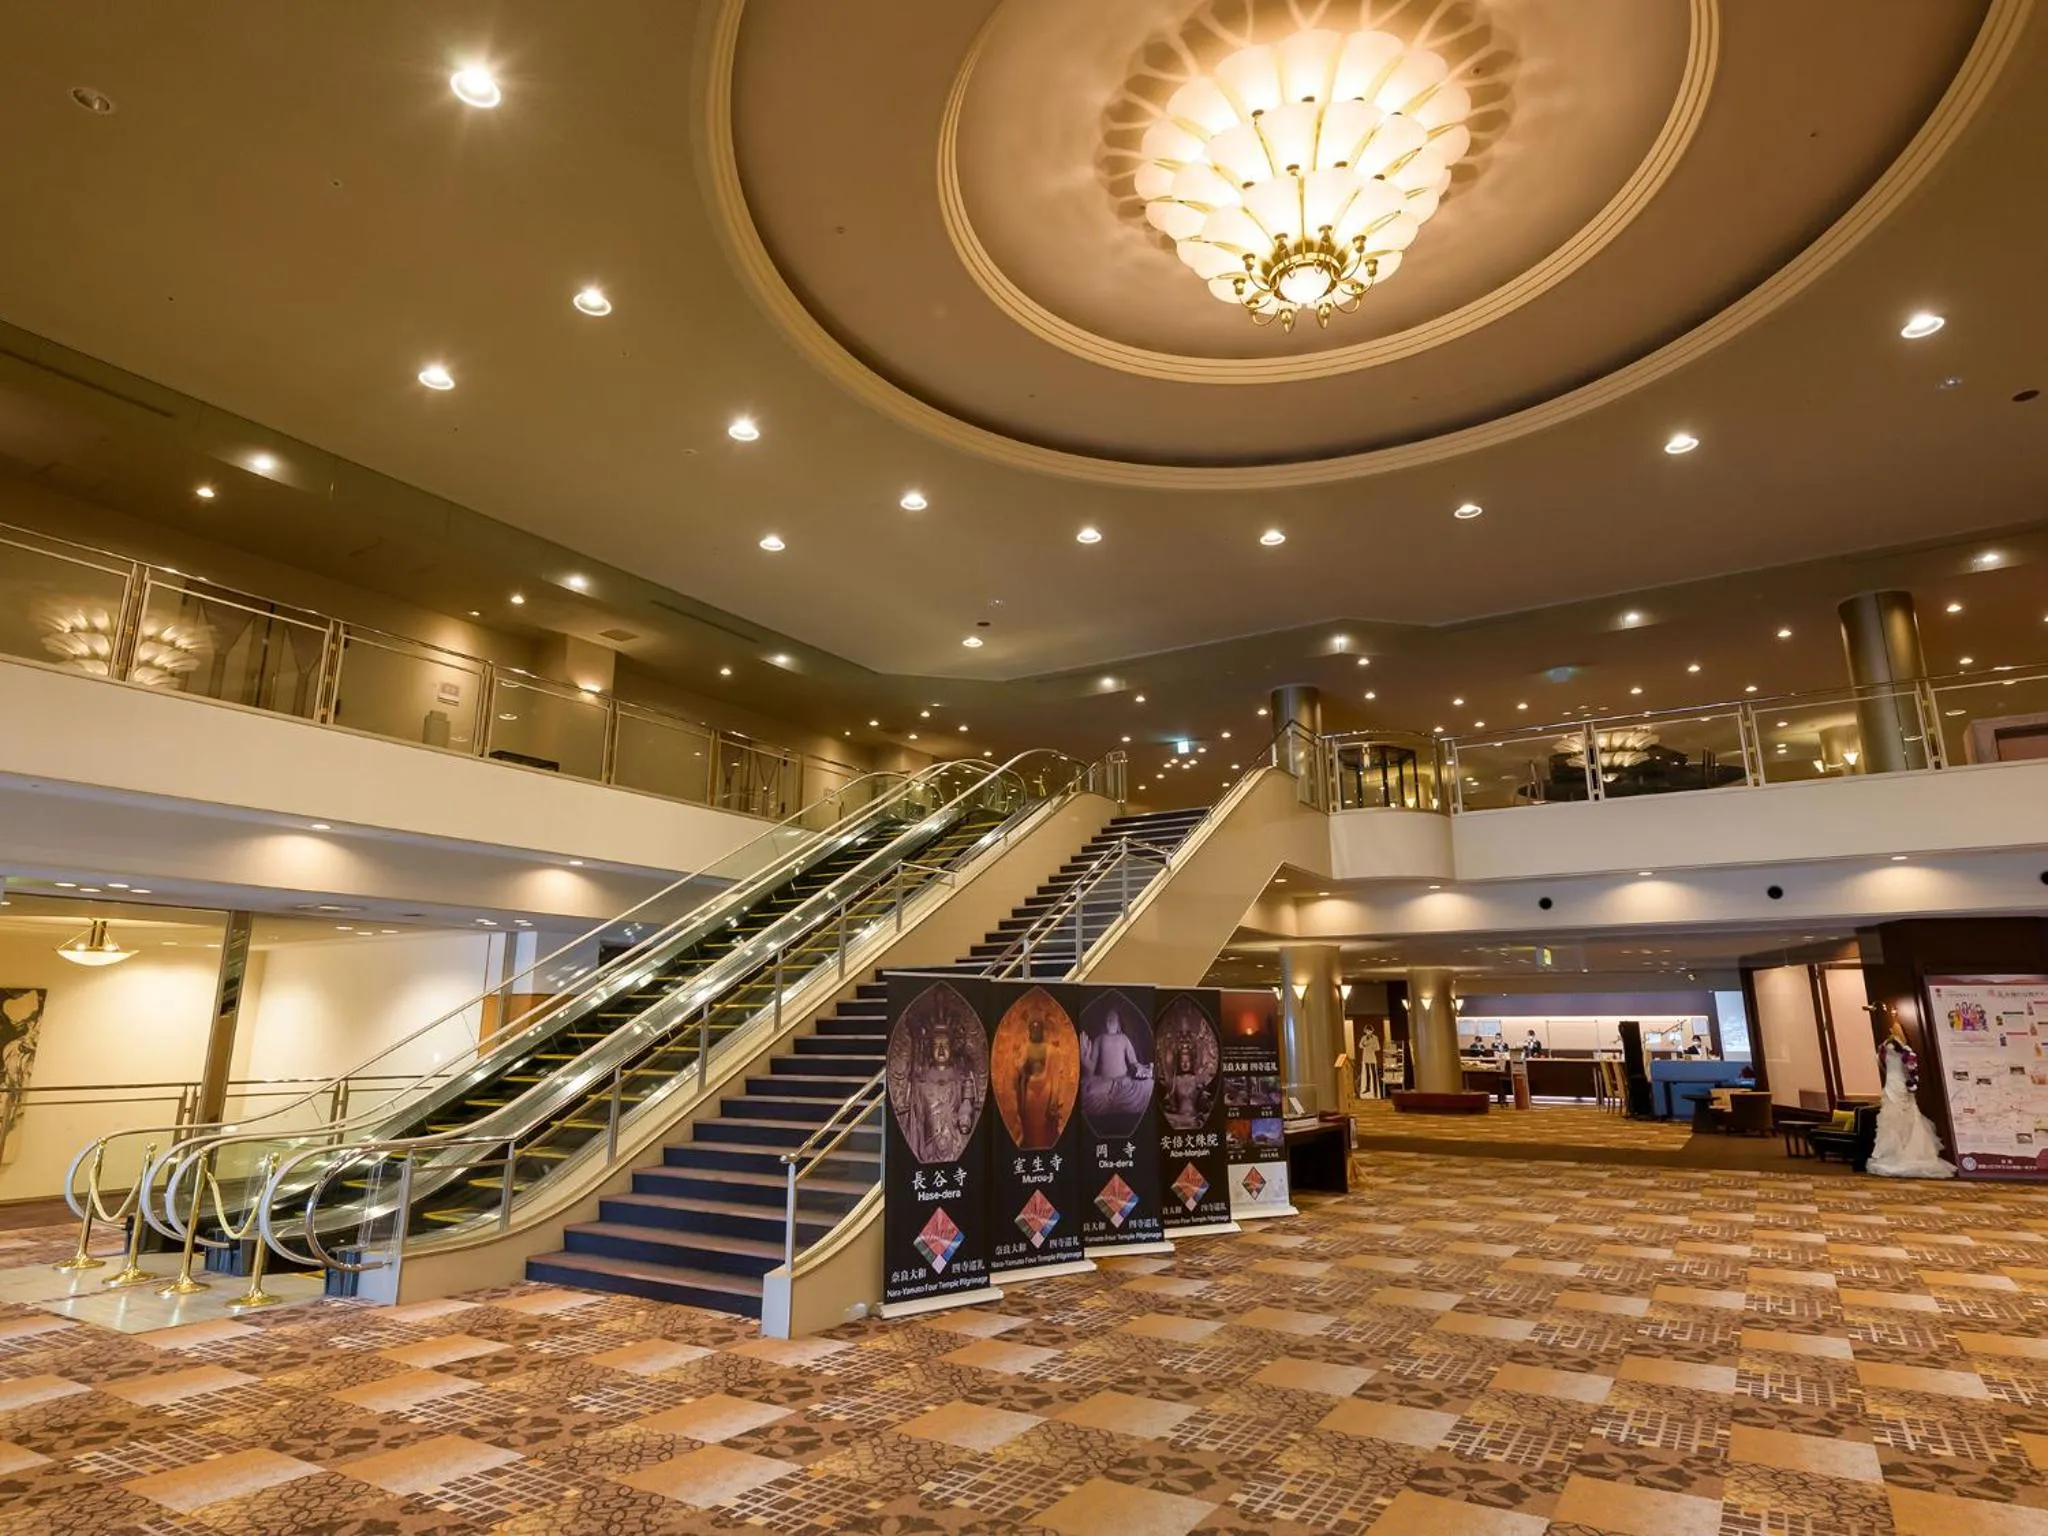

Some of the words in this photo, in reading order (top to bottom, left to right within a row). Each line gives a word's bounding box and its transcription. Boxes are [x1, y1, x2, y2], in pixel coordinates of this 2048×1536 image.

[1014, 1154, 1063, 1175] 室生寺
[1099, 1160, 1134, 1169] Oka-dera
[912, 1167, 968, 1191] 長谷寺
[918, 1189, 961, 1201] Hase-dera
[891, 1267, 927, 1283] 奈良大和
[939, 1280, 959, 1289] Temple
